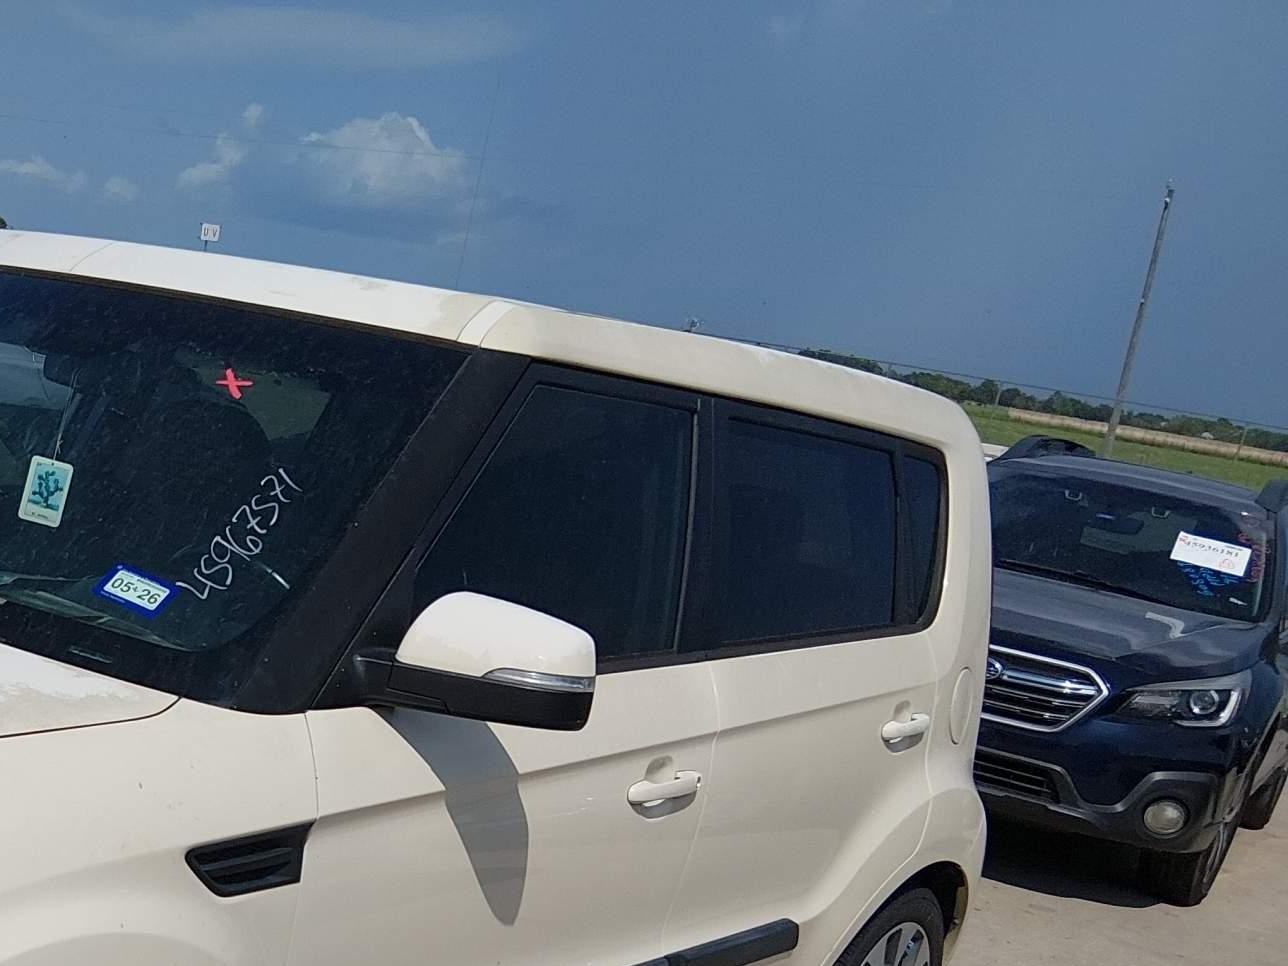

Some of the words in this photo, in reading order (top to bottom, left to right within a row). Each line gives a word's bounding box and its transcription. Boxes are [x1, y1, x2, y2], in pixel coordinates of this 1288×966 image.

[175, 467, 304, 600] 45967571
[111, 577, 135, 593] 05
[136, 588, 161, 605] 26
